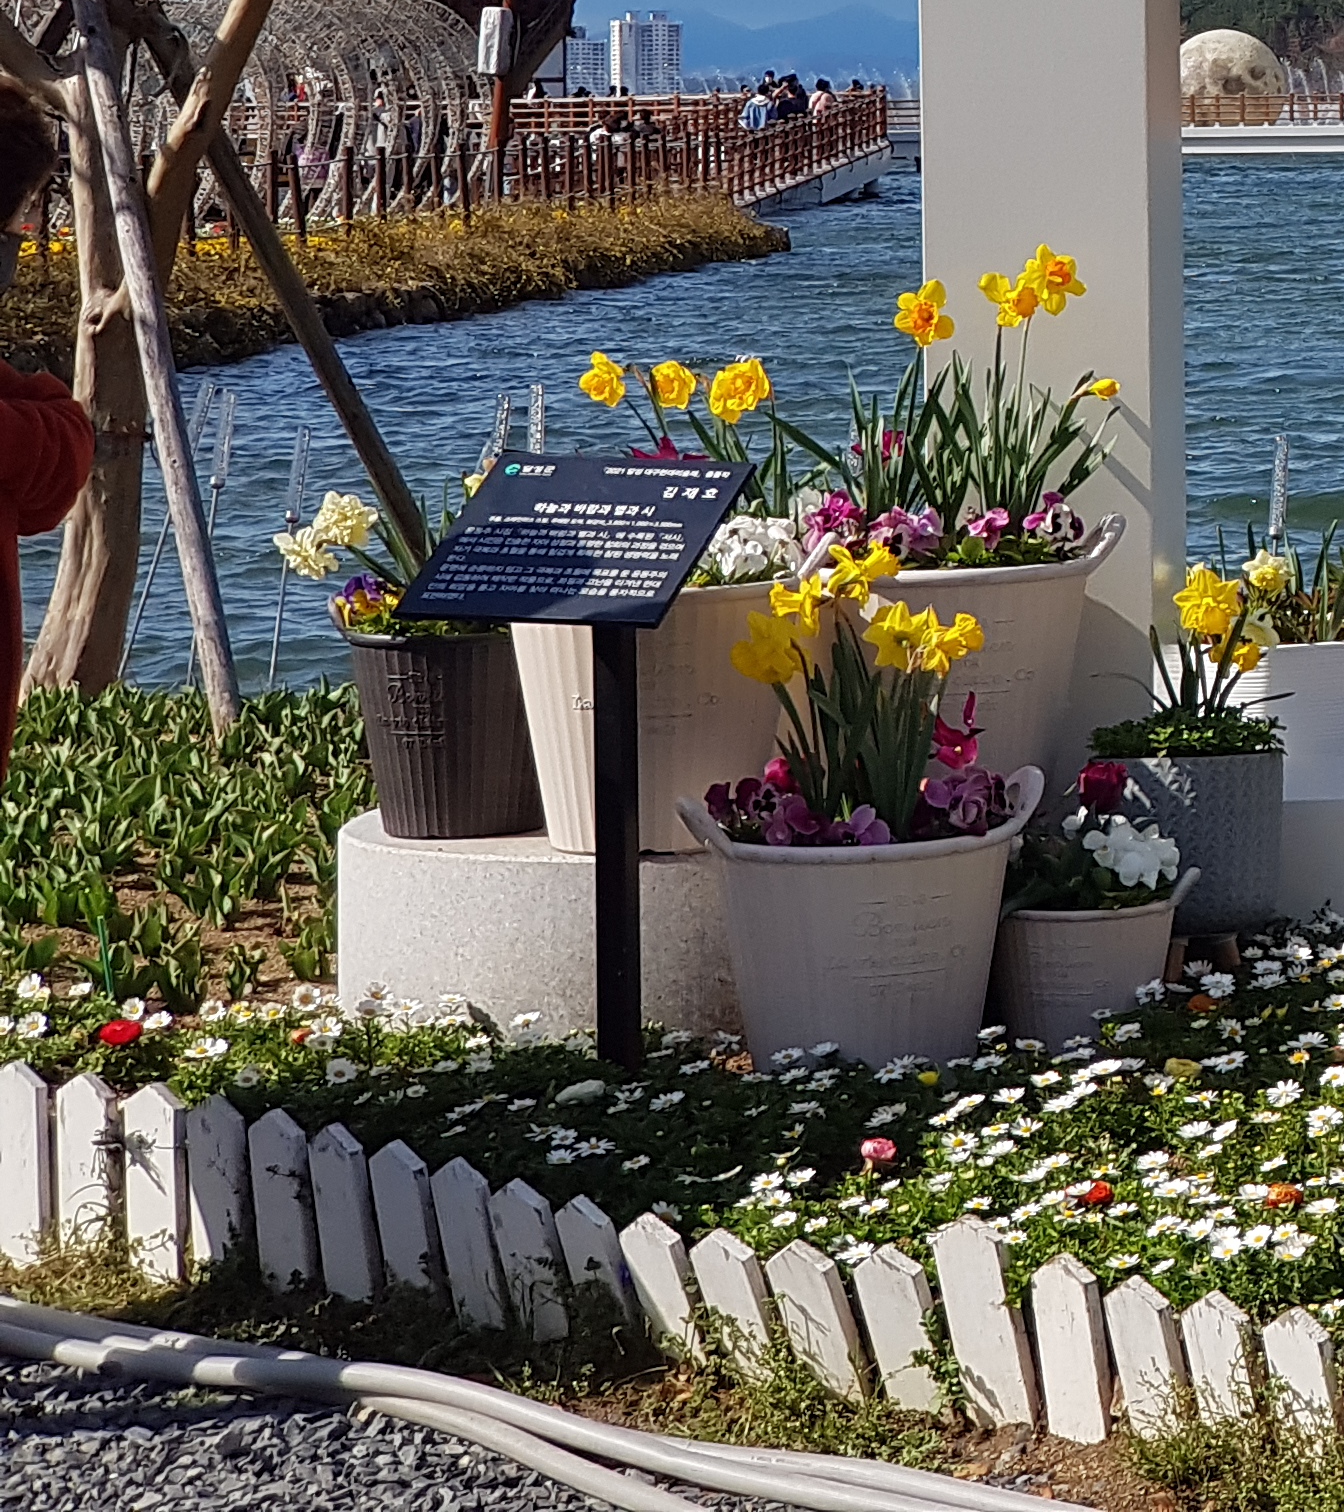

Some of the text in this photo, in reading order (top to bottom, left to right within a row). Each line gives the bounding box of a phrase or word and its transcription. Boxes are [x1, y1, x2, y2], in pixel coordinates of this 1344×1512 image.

[534, 501, 656, 517] 하늘과 바람과 별과 시
